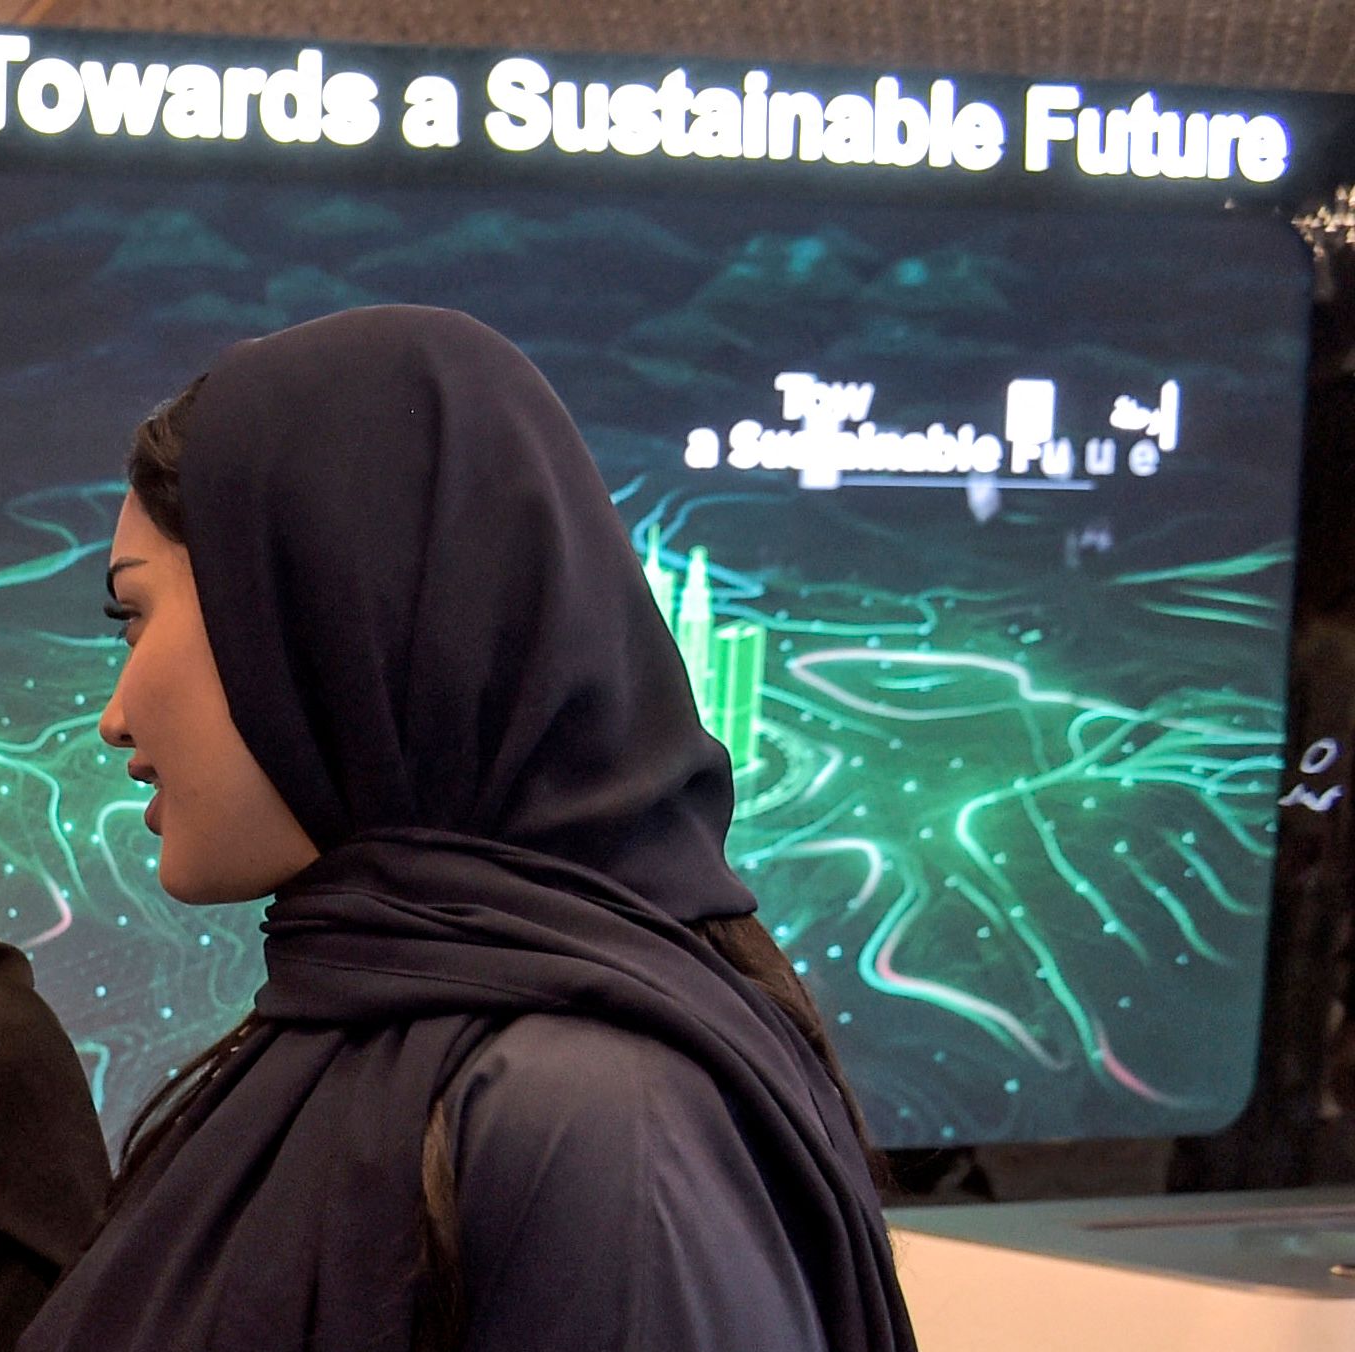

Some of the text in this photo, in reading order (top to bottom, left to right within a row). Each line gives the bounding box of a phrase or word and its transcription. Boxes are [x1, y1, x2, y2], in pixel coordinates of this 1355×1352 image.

[402, 75, 460, 148] a
[485, 58, 1005, 171] Sustainable
[1025, 85, 1288, 182] Future
[727, 419, 1003, 473] Suainable
